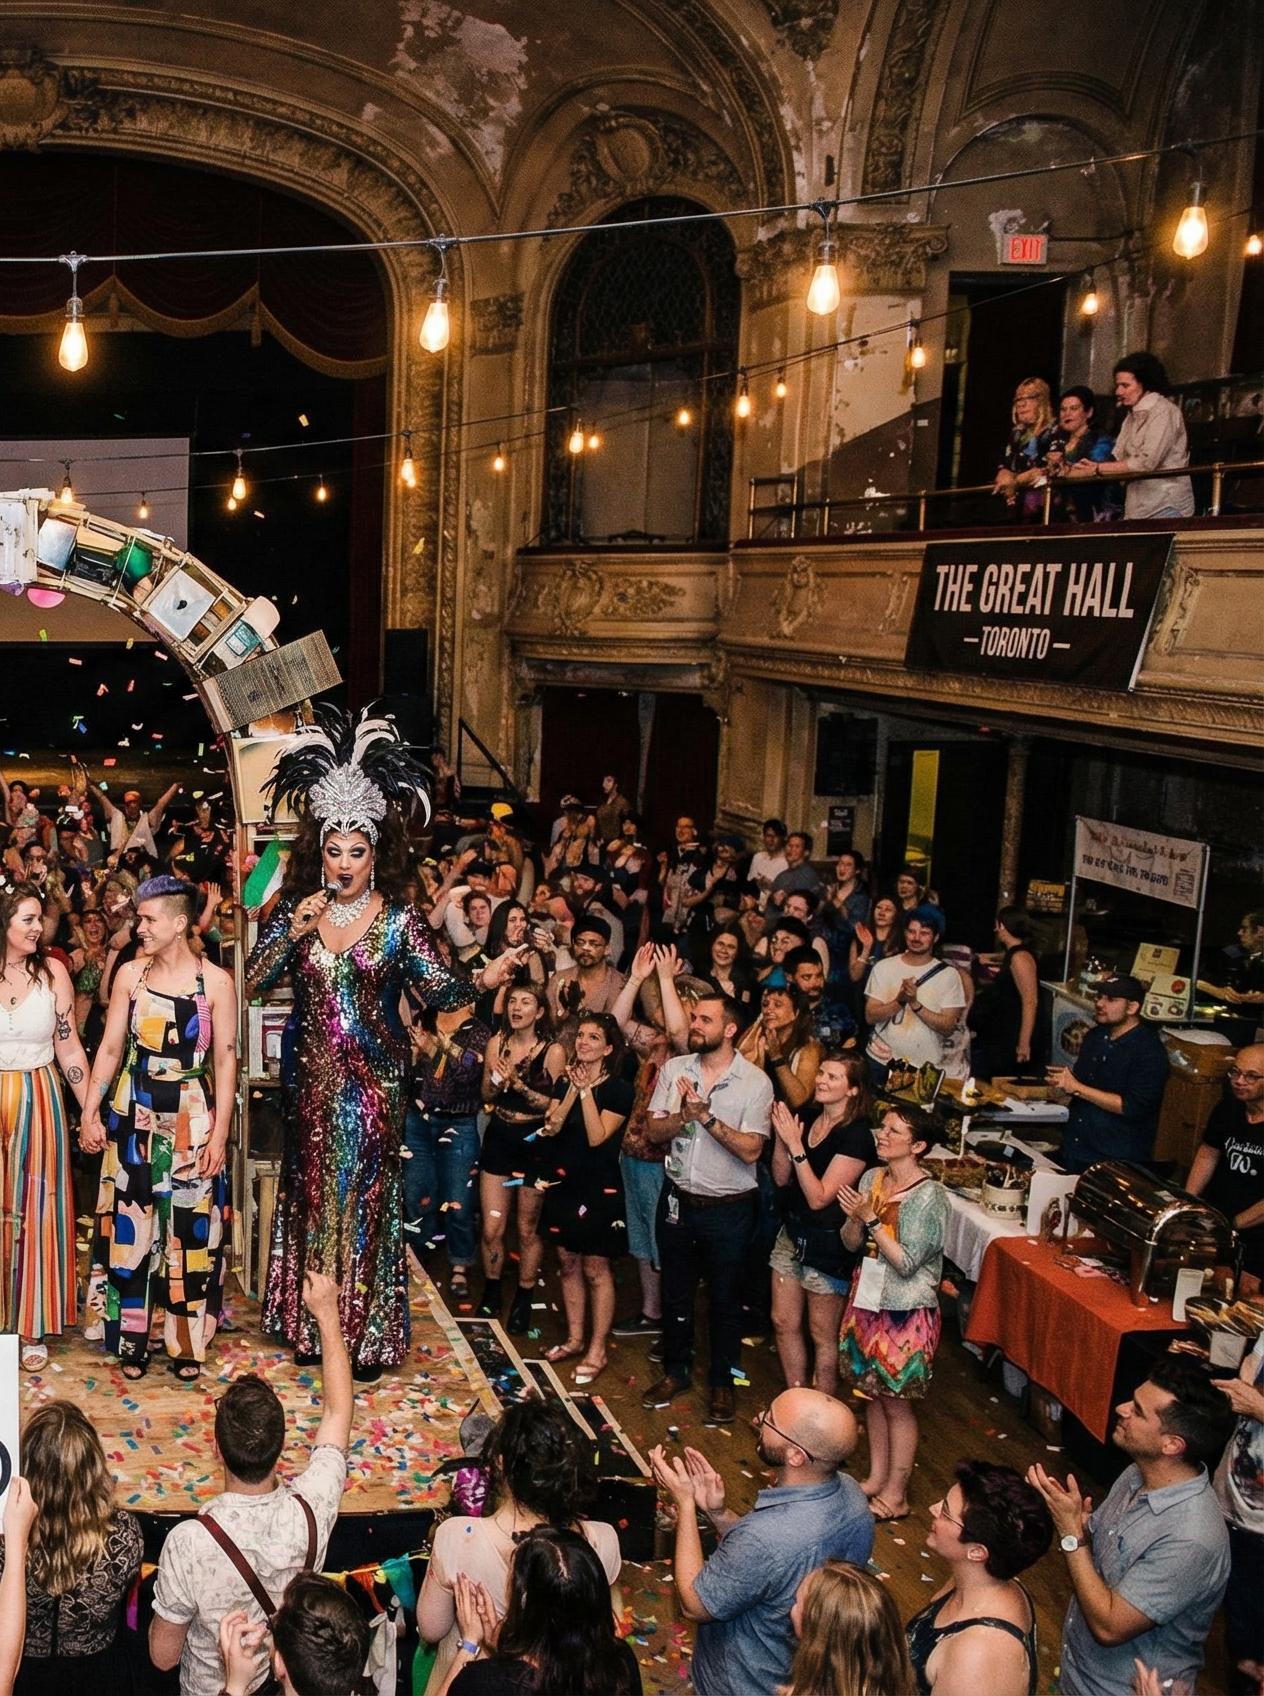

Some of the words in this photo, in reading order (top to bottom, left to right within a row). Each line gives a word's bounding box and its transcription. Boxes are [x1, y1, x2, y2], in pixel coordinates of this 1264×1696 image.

[1011, 237, 1041, 260] EXIT
[934, 564, 978, 612] THE
[979, 563, 1062, 616] GREAT
[1063, 562, 1135, 619] HALL
